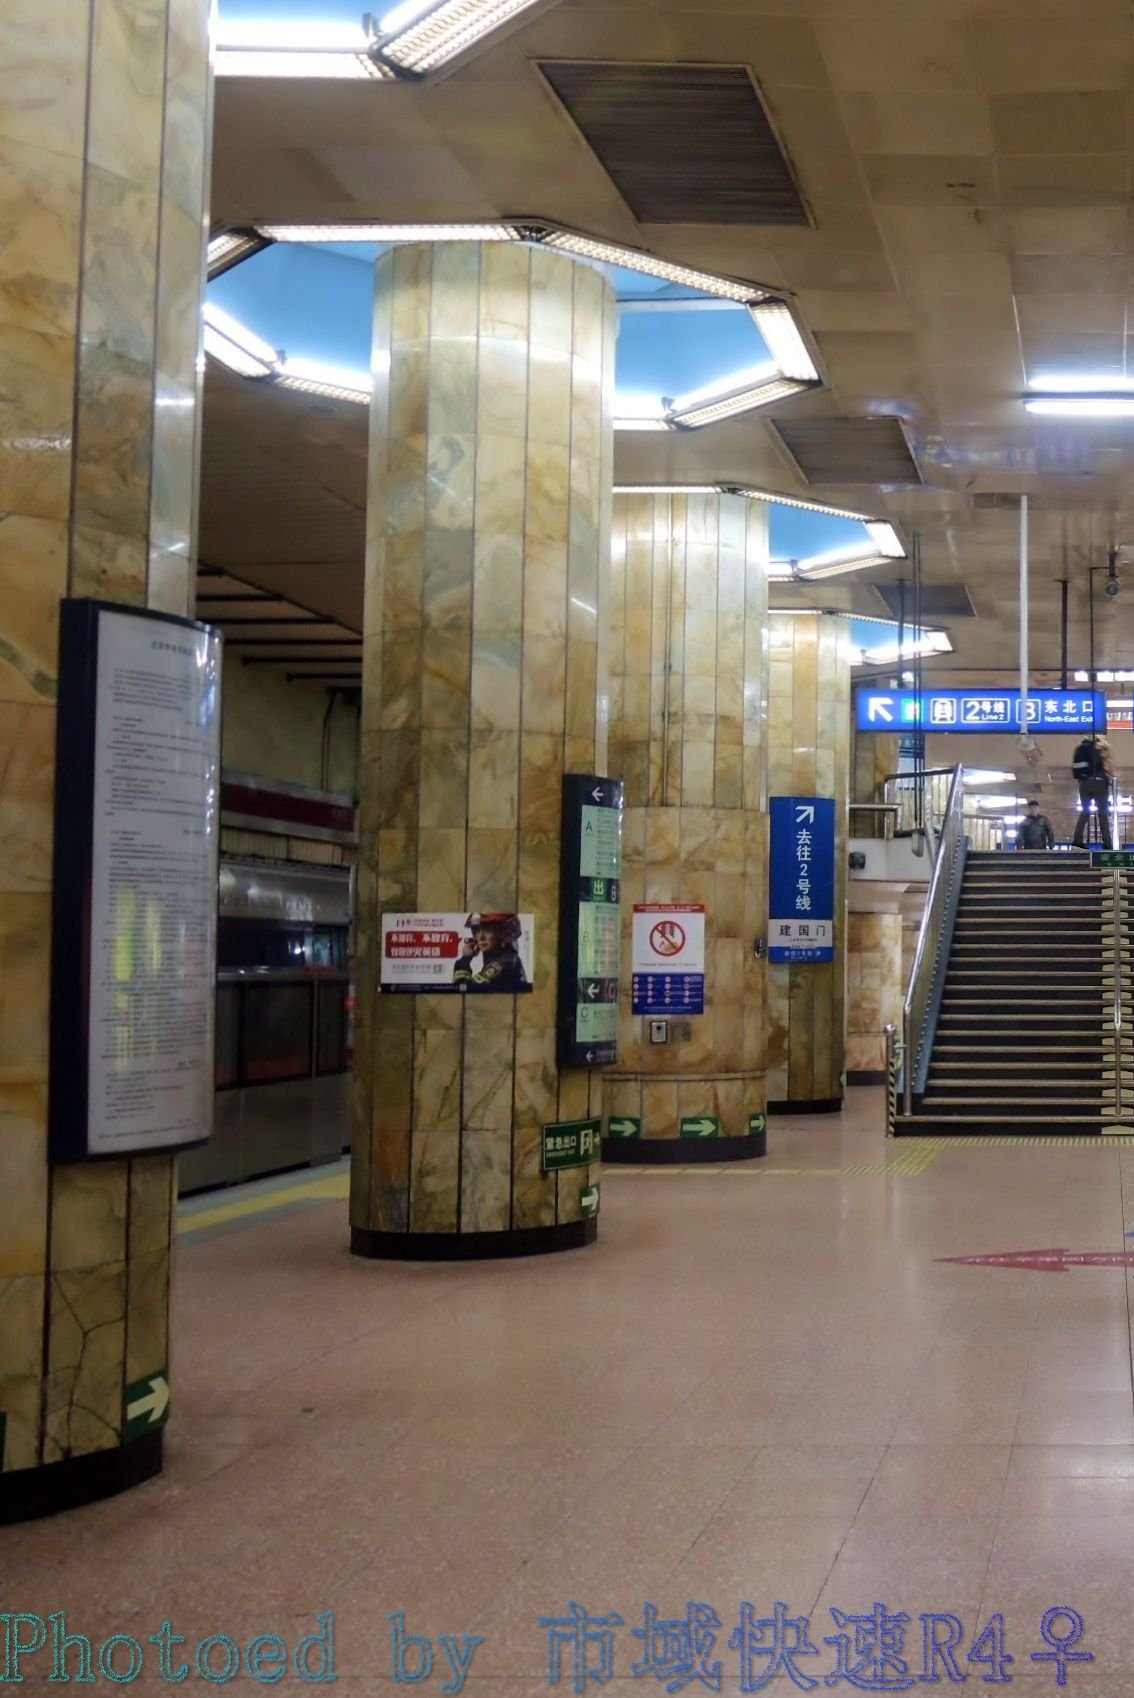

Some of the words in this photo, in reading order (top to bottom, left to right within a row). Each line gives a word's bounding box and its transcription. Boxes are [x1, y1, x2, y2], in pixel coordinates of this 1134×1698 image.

[1045, 699, 1093, 713] 东北口
[795, 828, 813, 911] 去往2号线
[780, 924, 826, 937] 建国门
